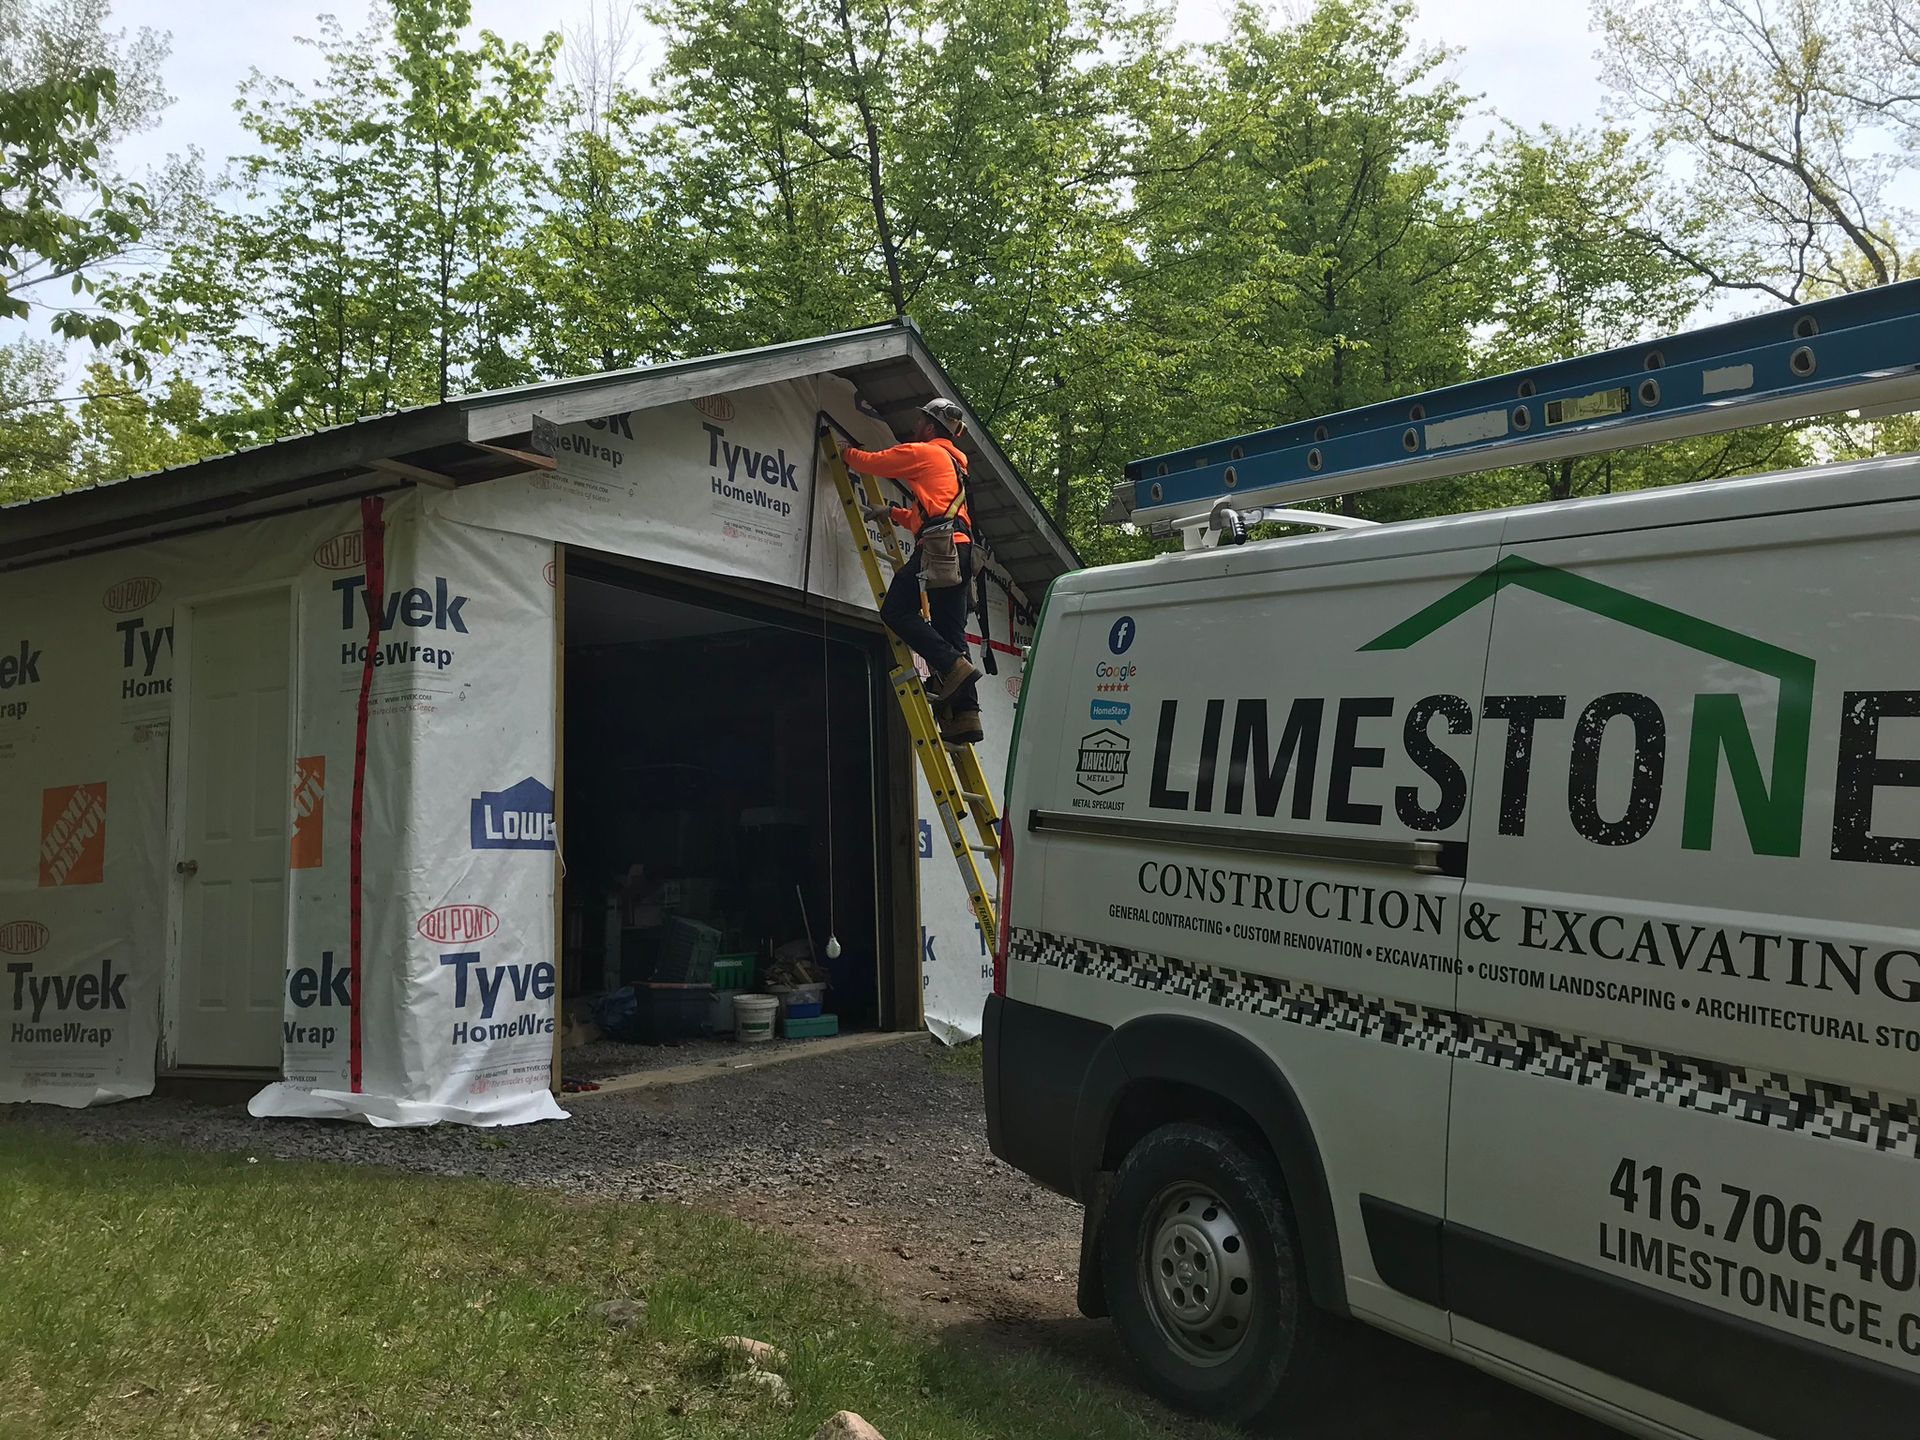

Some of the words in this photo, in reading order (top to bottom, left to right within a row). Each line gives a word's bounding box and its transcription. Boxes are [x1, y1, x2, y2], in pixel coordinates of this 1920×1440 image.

[702, 421, 799, 492] Tyvek
[711, 476, 791, 518] HomeWrap
[1096, 661, 1136, 682] Google
[1093, 705, 1128, 716] HomeStars
[1081, 751, 1127, 772] HAVELOCK
[1148, 690, 1920, 867] LIMESTONE
[1072, 798, 1091, 809] METAL
[1091, 800, 1125, 811] SPECIALIST
[1138, 860, 1447, 936] CONSTRUCTION
[1463, 901, 1501, 943] &
[1518, 905, 1920, 1004] EXCAVATING
[7, 960, 128, 1023] Tyvek
[1108, 903, 1151, 924] GENERAL
[1152, 911, 1223, 936] CONTRACTING
[1233, 923, 1281, 946] CUSTOM
[1283, 932, 1363, 960] RENOVATION
[1375, 945, 1463, 976] EXCAVATING
[1478, 962, 1546, 990] CUSTOM
[1549, 974, 1676, 1012] LANDSCAPING
[1695, 996, 1869, 1045] ARCHITECTURAL
[10, 1023, 112, 1048] HomeWrap
